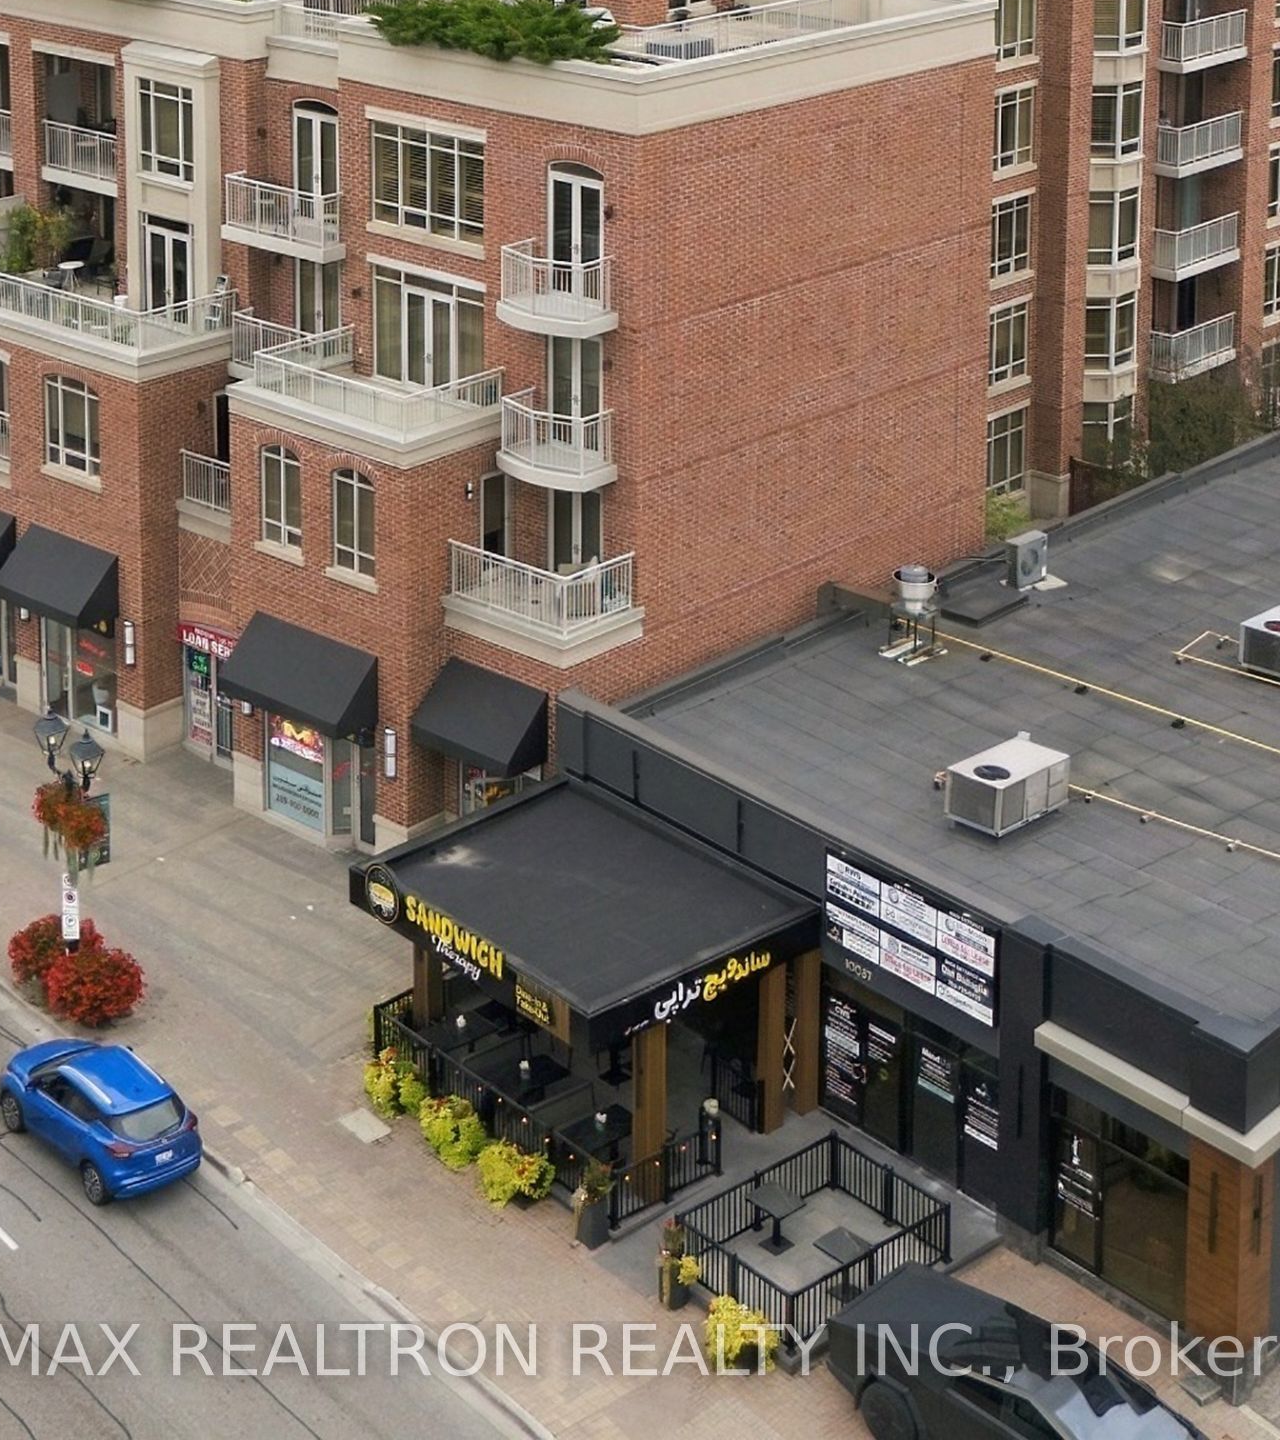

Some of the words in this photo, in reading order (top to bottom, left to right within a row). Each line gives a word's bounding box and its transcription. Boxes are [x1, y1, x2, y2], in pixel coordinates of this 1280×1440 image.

[182, 629, 209, 651] LOAN
[405, 895, 504, 979] SANDWICH
[431, 934, 482, 981] Therapy
[703, 951, 771, 1002] ساندویچ
